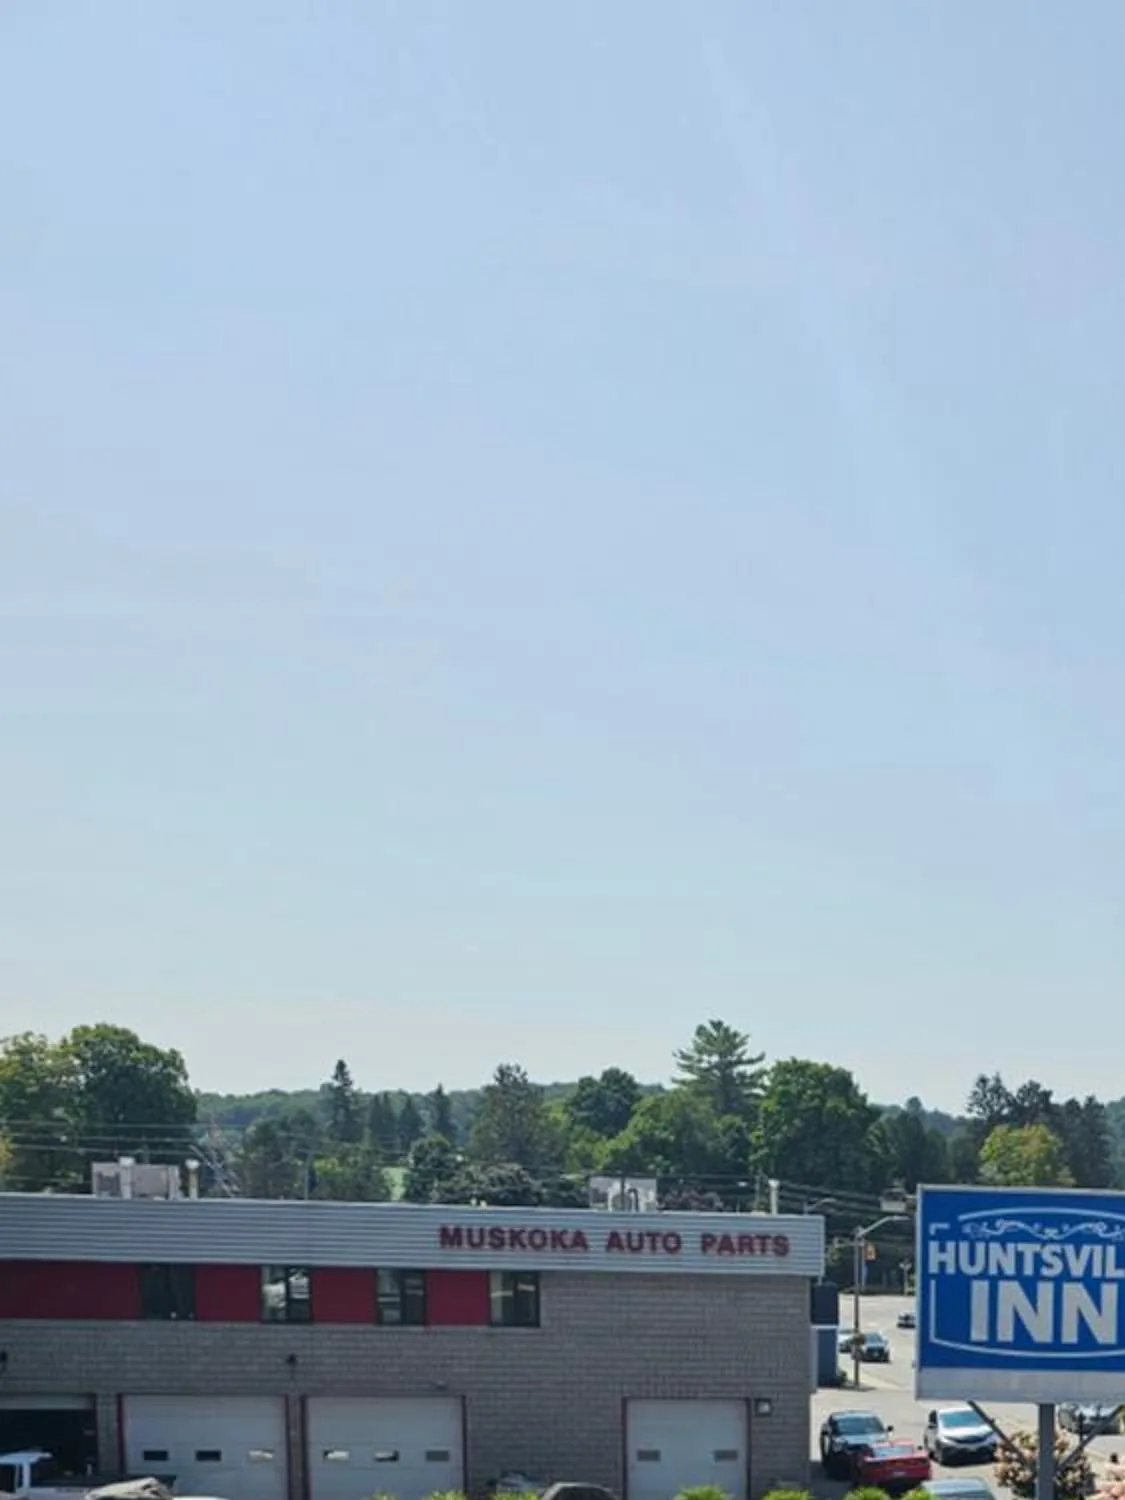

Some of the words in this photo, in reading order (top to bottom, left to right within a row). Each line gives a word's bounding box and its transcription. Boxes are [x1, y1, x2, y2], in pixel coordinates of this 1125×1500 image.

[439, 1226, 589, 1251] MUSKOKA
[605, 1230, 682, 1254] AUTO
[701, 1233, 790, 1257] PARTS
[970, 1280, 1118, 1345] INN
